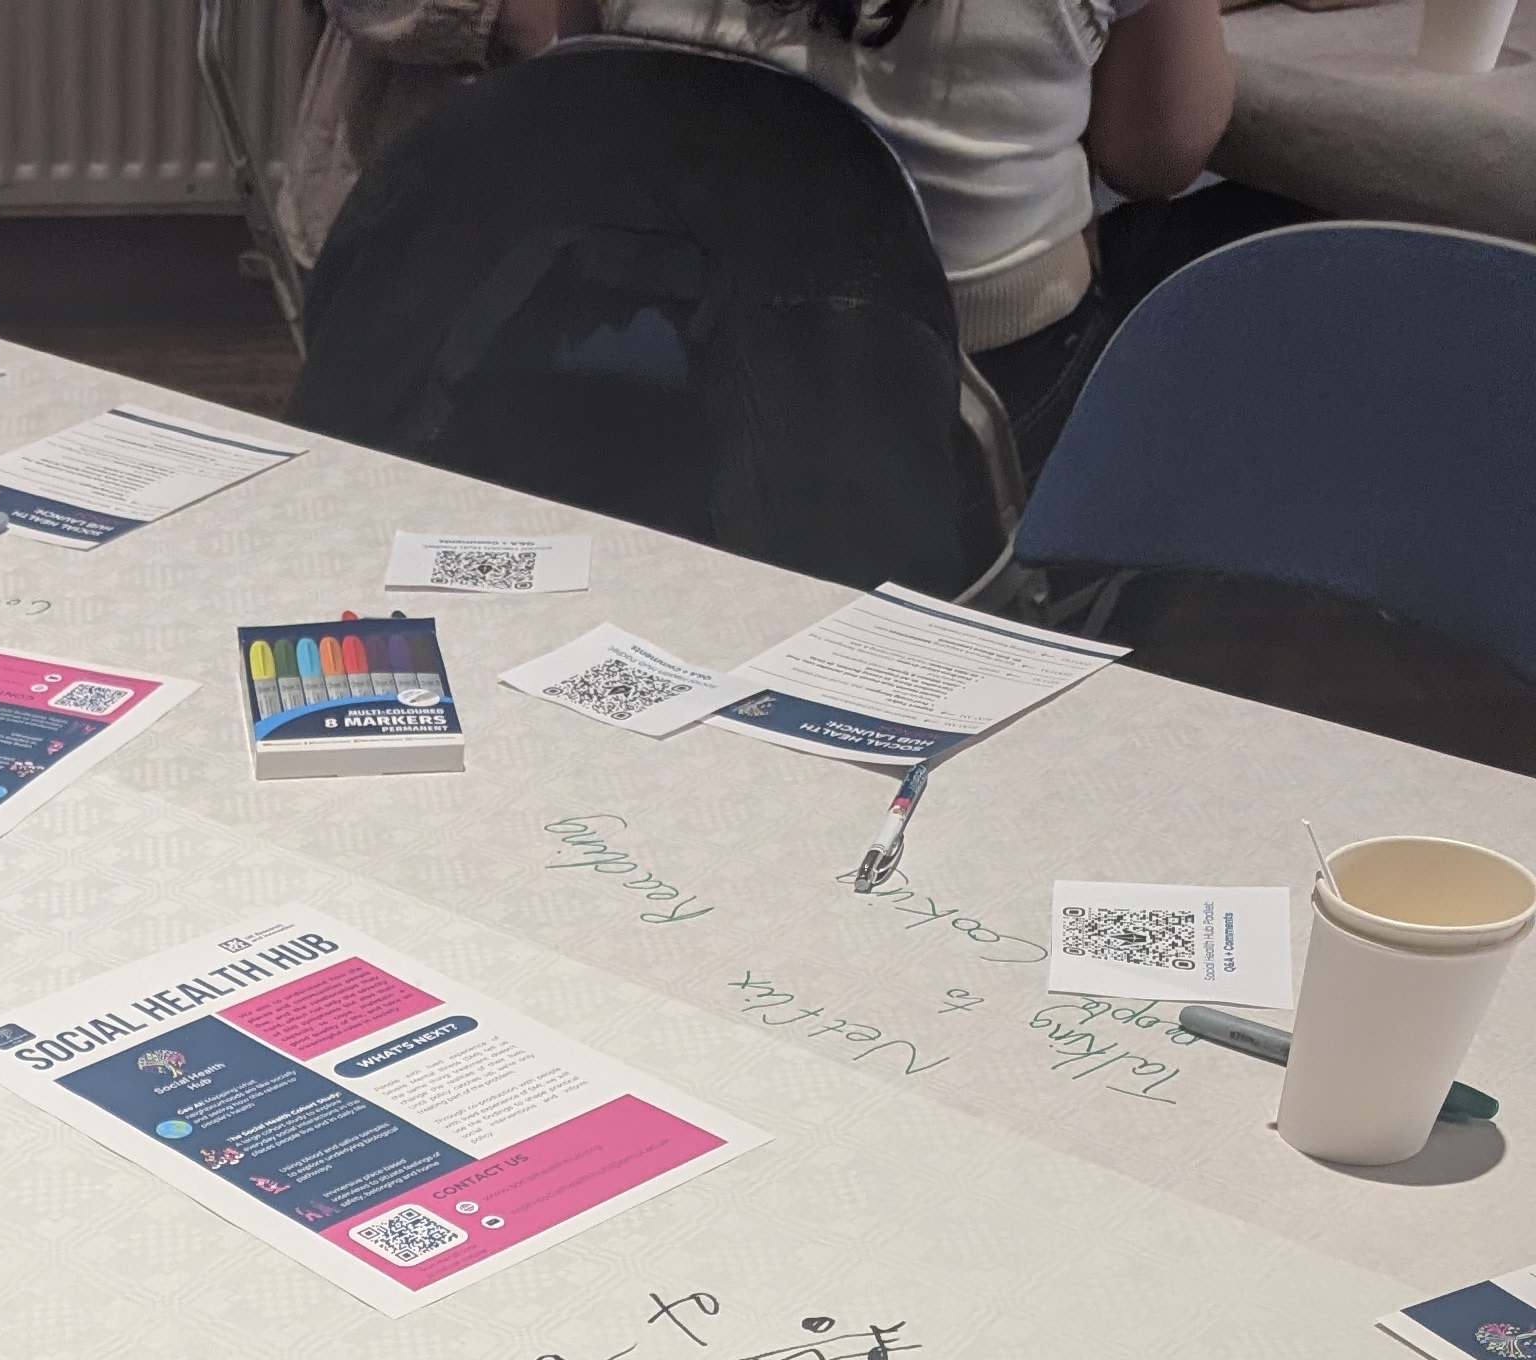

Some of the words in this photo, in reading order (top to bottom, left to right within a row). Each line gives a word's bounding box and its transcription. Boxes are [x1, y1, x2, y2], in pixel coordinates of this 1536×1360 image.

[324, 718, 338, 728] 8
[344, 715, 447, 727] MARKERS
[348, 709, 445, 717] MULTI-COLOURED
[381, 725, 448, 733] PERMANENT
[799, 722, 865, 745] HEALTH
[896, 736, 934, 747] HUB
[867, 738, 924, 752] SOCIAL
[544, 813, 715, 924] Reading
[14, 1013, 148, 1070] SOCIAL
[131, 959, 274, 1022] HEALTH
[256, 934, 339, 970] HUB
[937, 988, 984, 1014] to
[356, 1042, 414, 1068] WHAT'S
[412, 1023, 458, 1044] NEXT?
[1029, 1004, 1180, 1104] Talking
[154, 1076, 190, 1094] Social
[188, 1064, 226, 1080] Health
[187, 1078, 212, 1090] Hub
[432, 1163, 505, 1199] CONTACT
[504, 1154, 529, 1166] US
[648, 1291, 720, 1347] to
